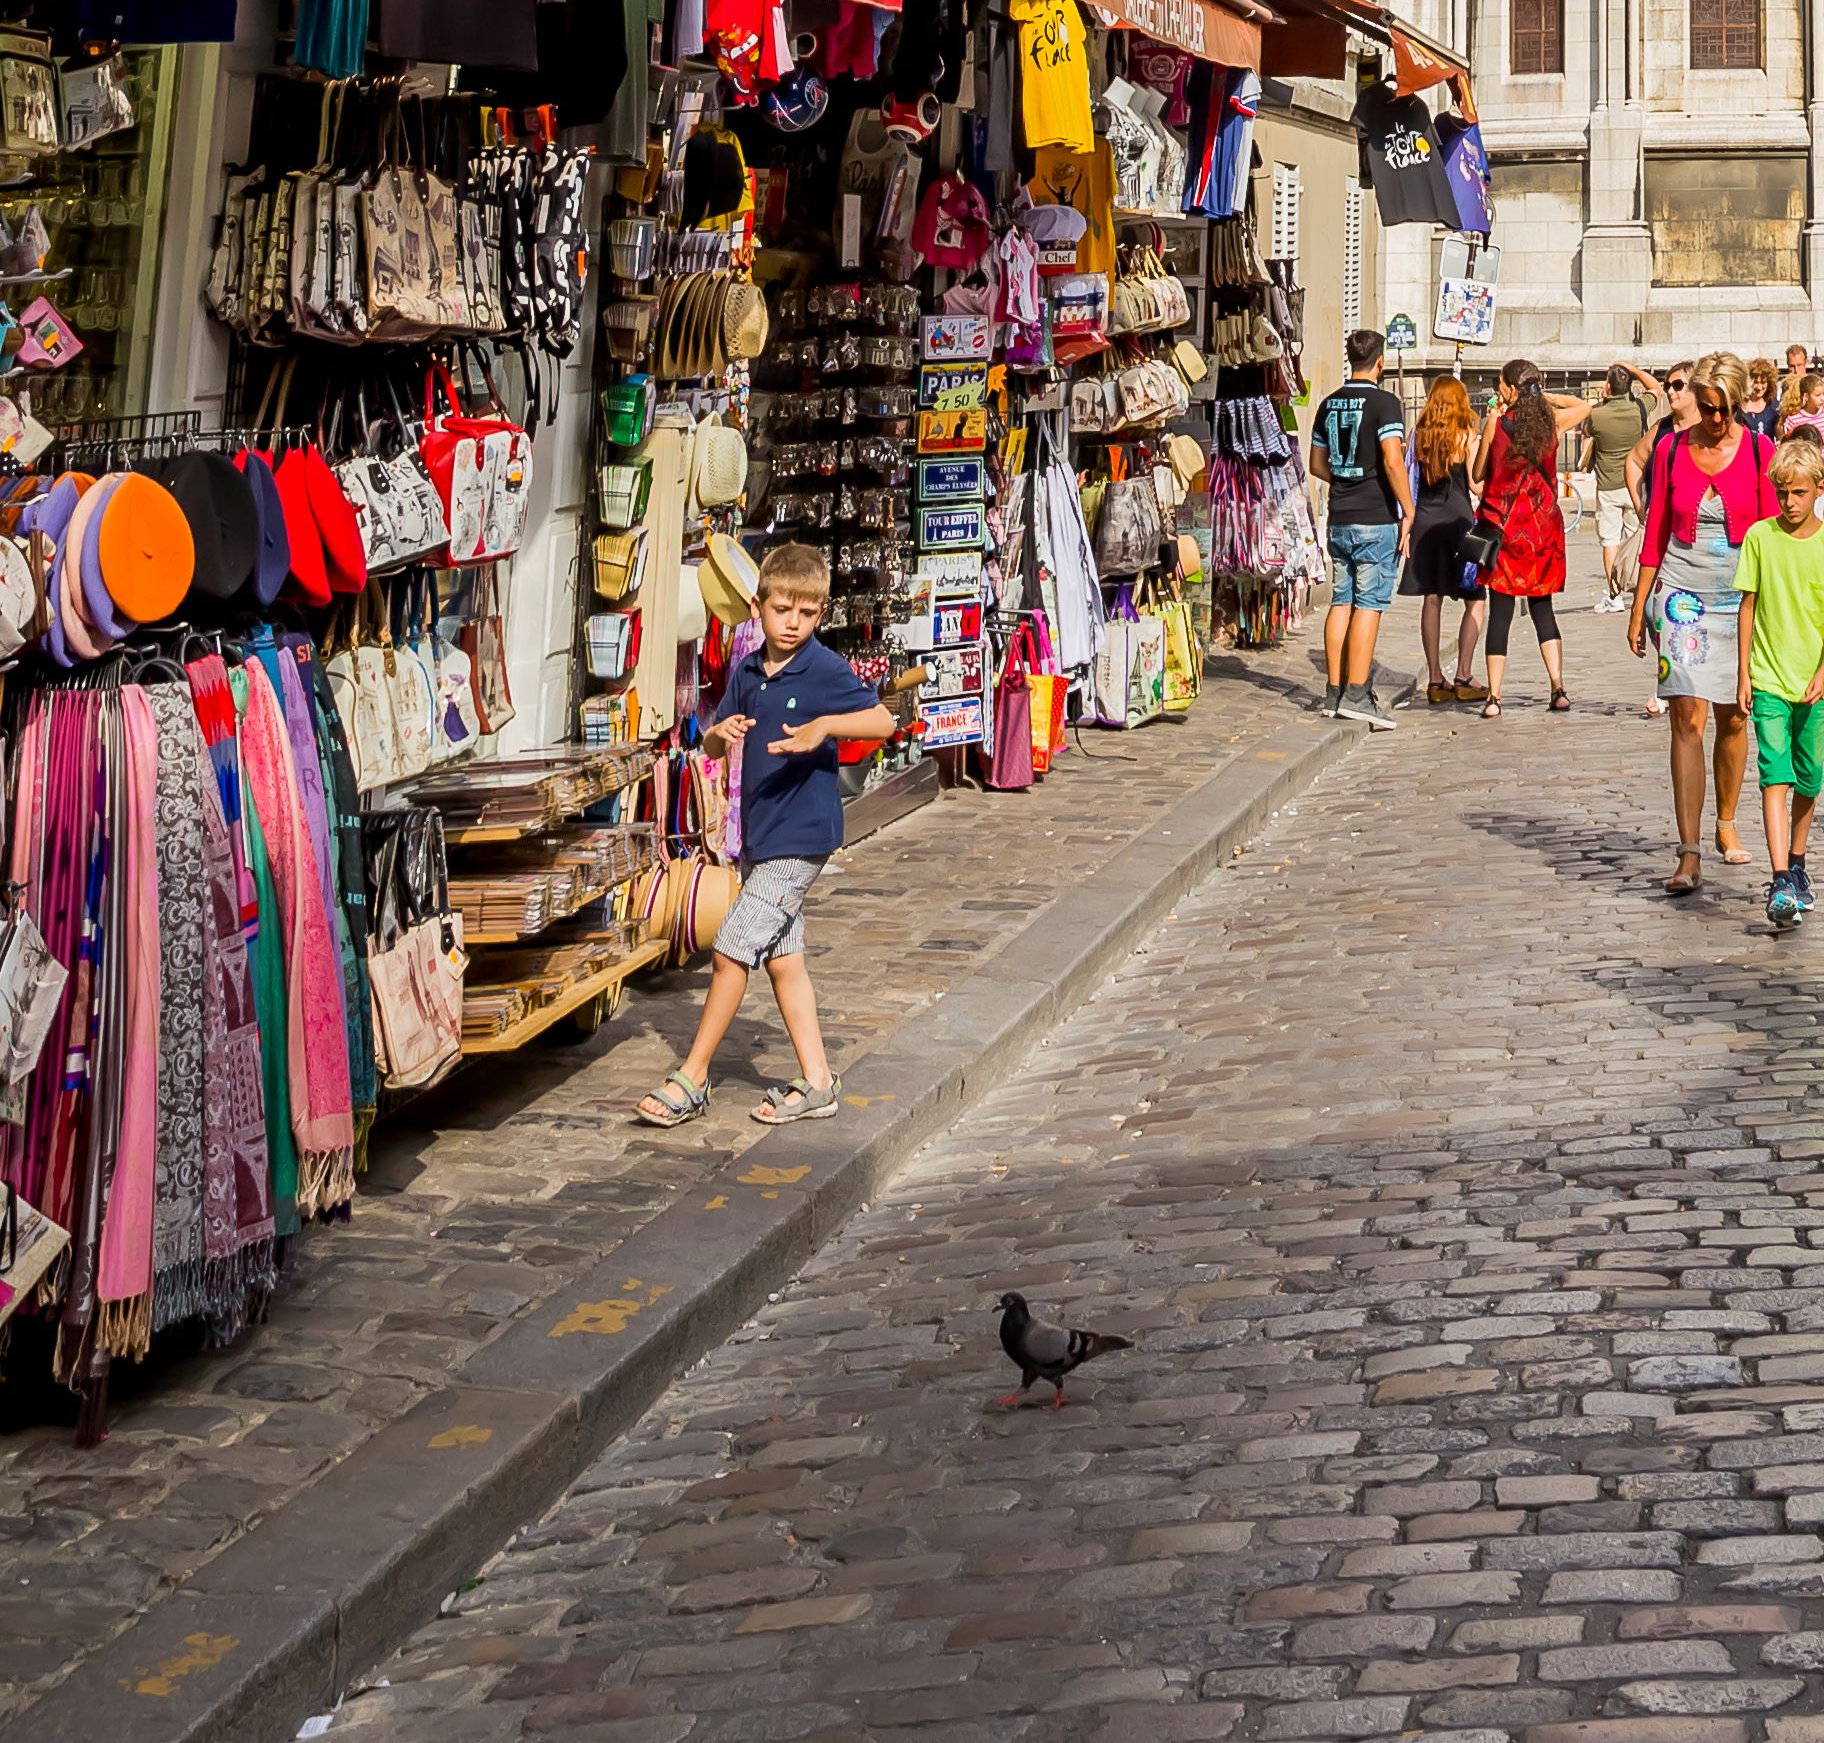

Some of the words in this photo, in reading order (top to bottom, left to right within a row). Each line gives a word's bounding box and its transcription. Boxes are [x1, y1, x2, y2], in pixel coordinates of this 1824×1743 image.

[1044, 252, 1071, 263] Chef
[941, 398, 949, 411] 7
[954, 393, 970, 409] 50
[1325, 410, 1364, 467] 17
[939, 465, 966, 474] AVENUE
[927, 516, 950, 528] TOUR
[950, 514, 978, 525] EIFFEL
[941, 529, 965, 539] PARIS
[933, 555, 967, 566] PARIS
[936, 713, 967, 729] FRANCE
